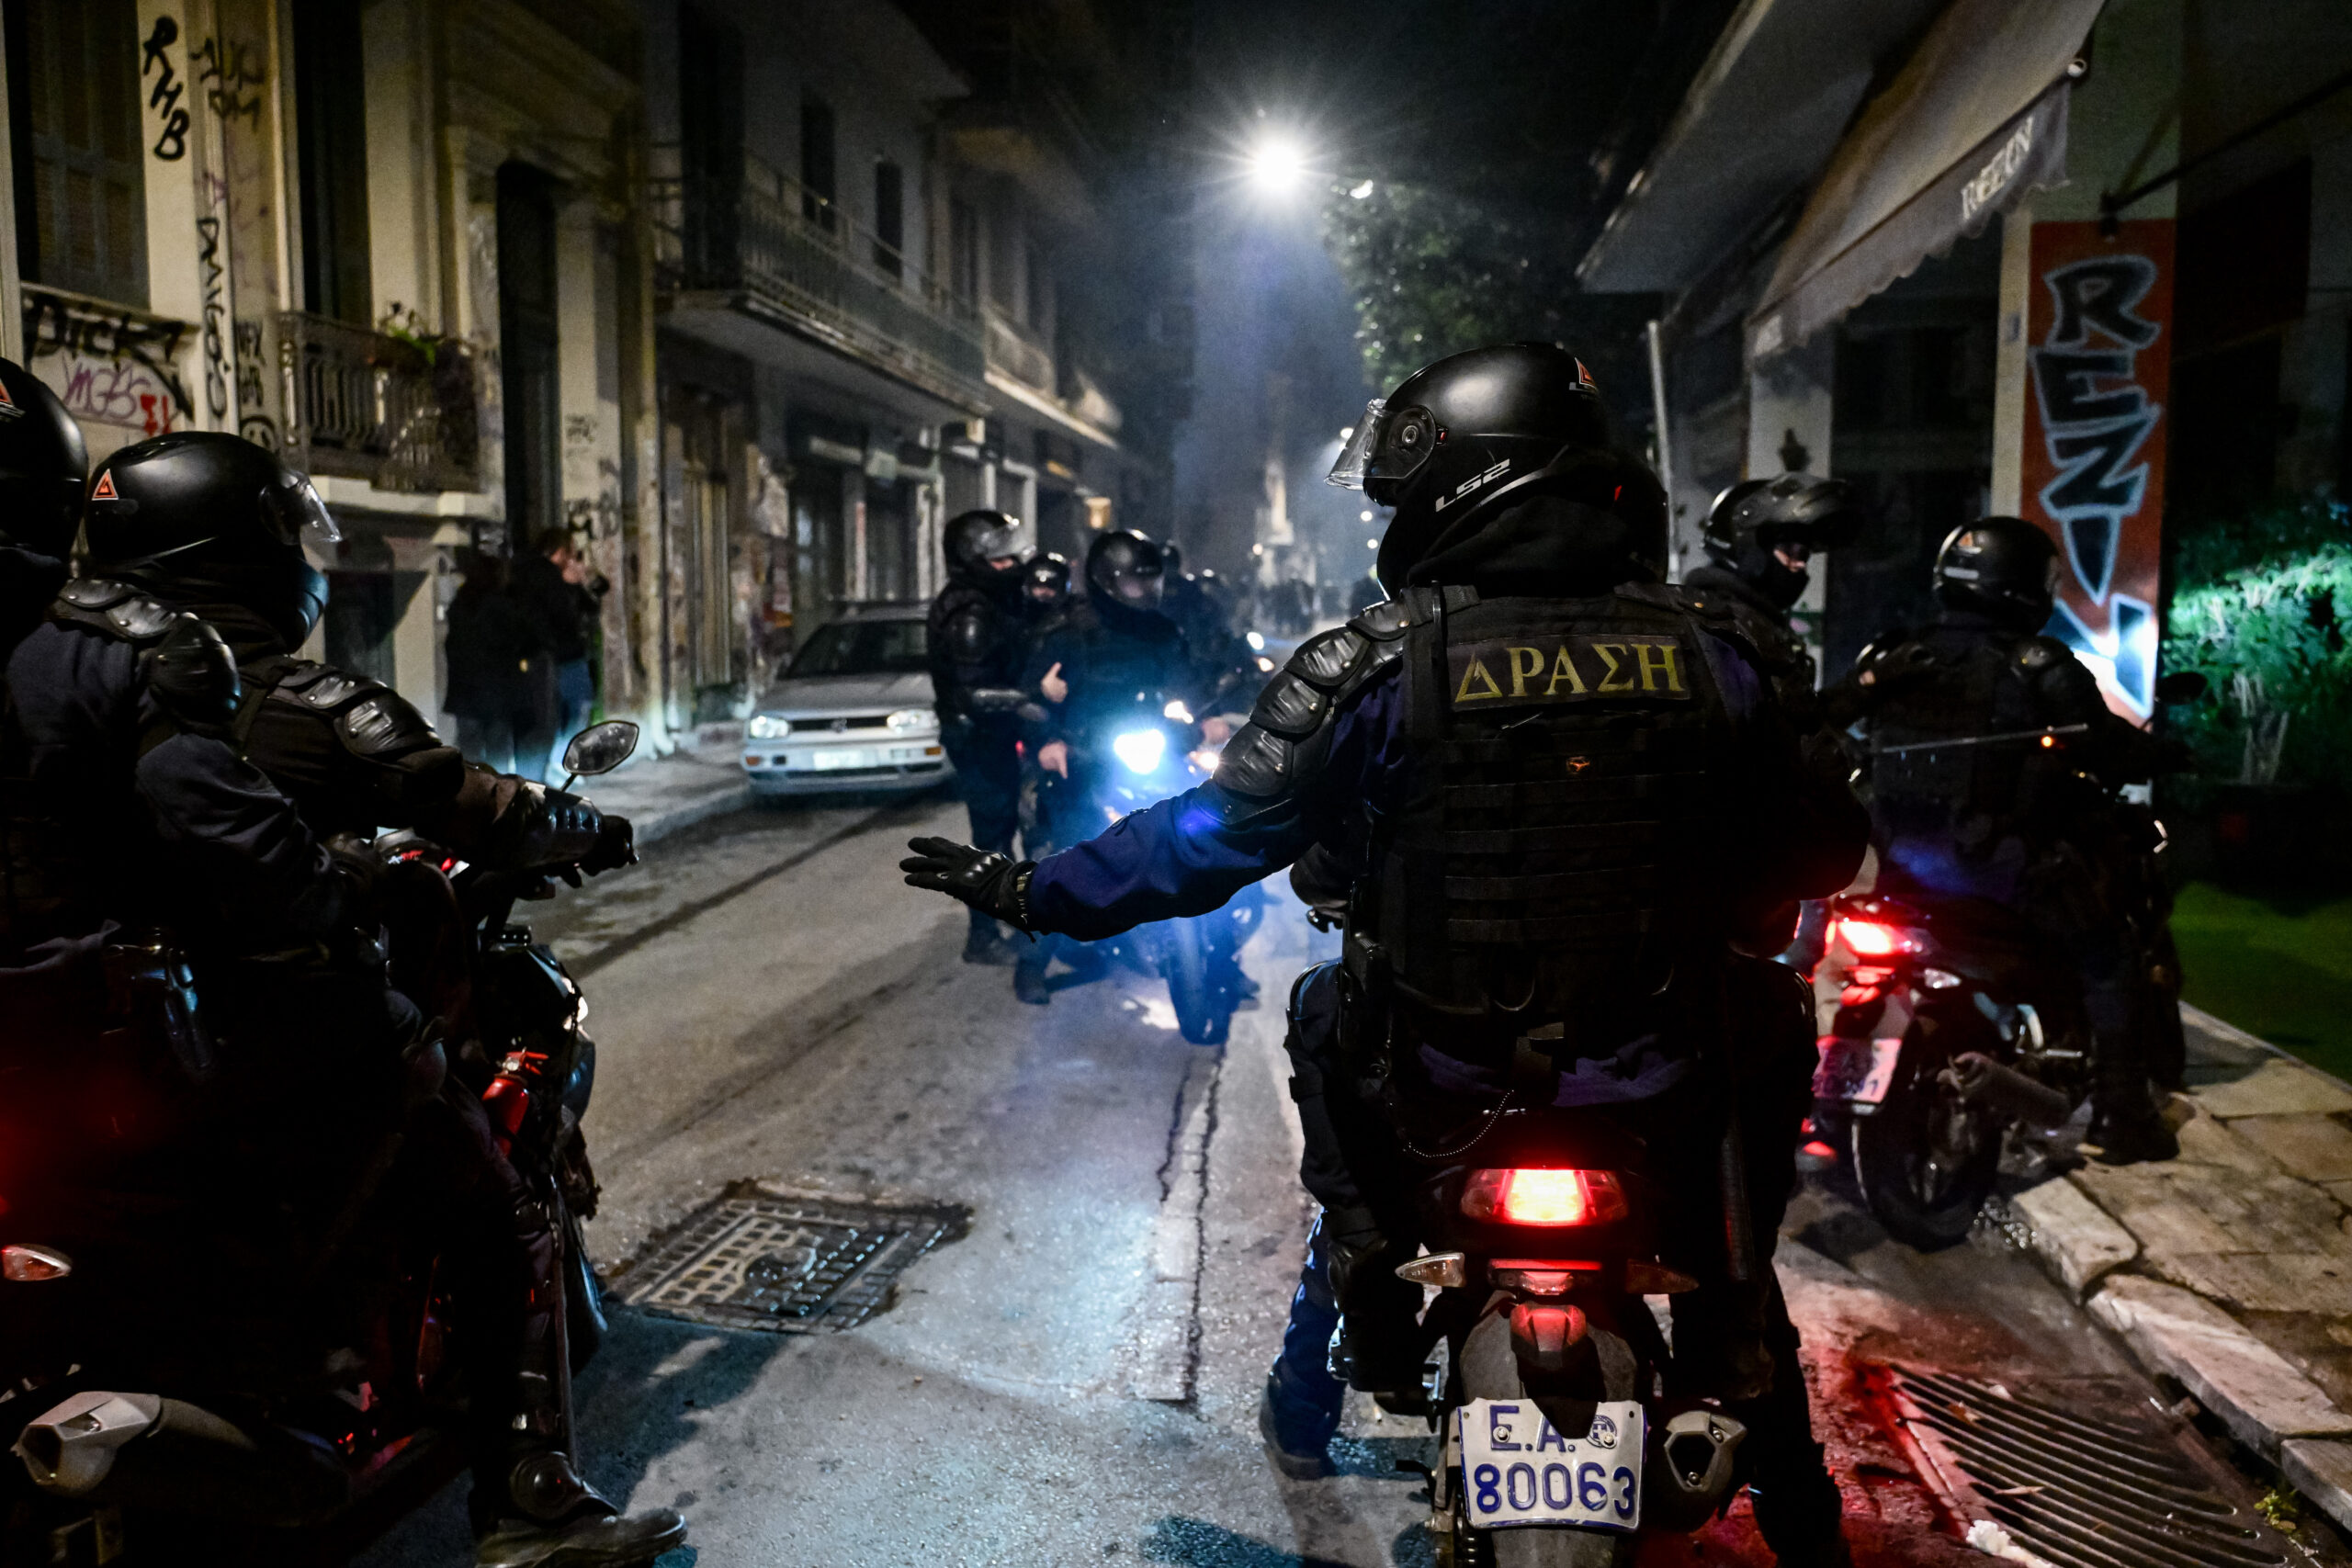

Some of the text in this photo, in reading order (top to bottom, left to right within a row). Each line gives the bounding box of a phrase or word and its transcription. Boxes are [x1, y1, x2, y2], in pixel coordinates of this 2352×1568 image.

[1435, 458, 1512, 513] LS2
[1454, 643, 1687, 704] ΔΡΑΣΗ
[1474, 1461, 1636, 1520] 80063
